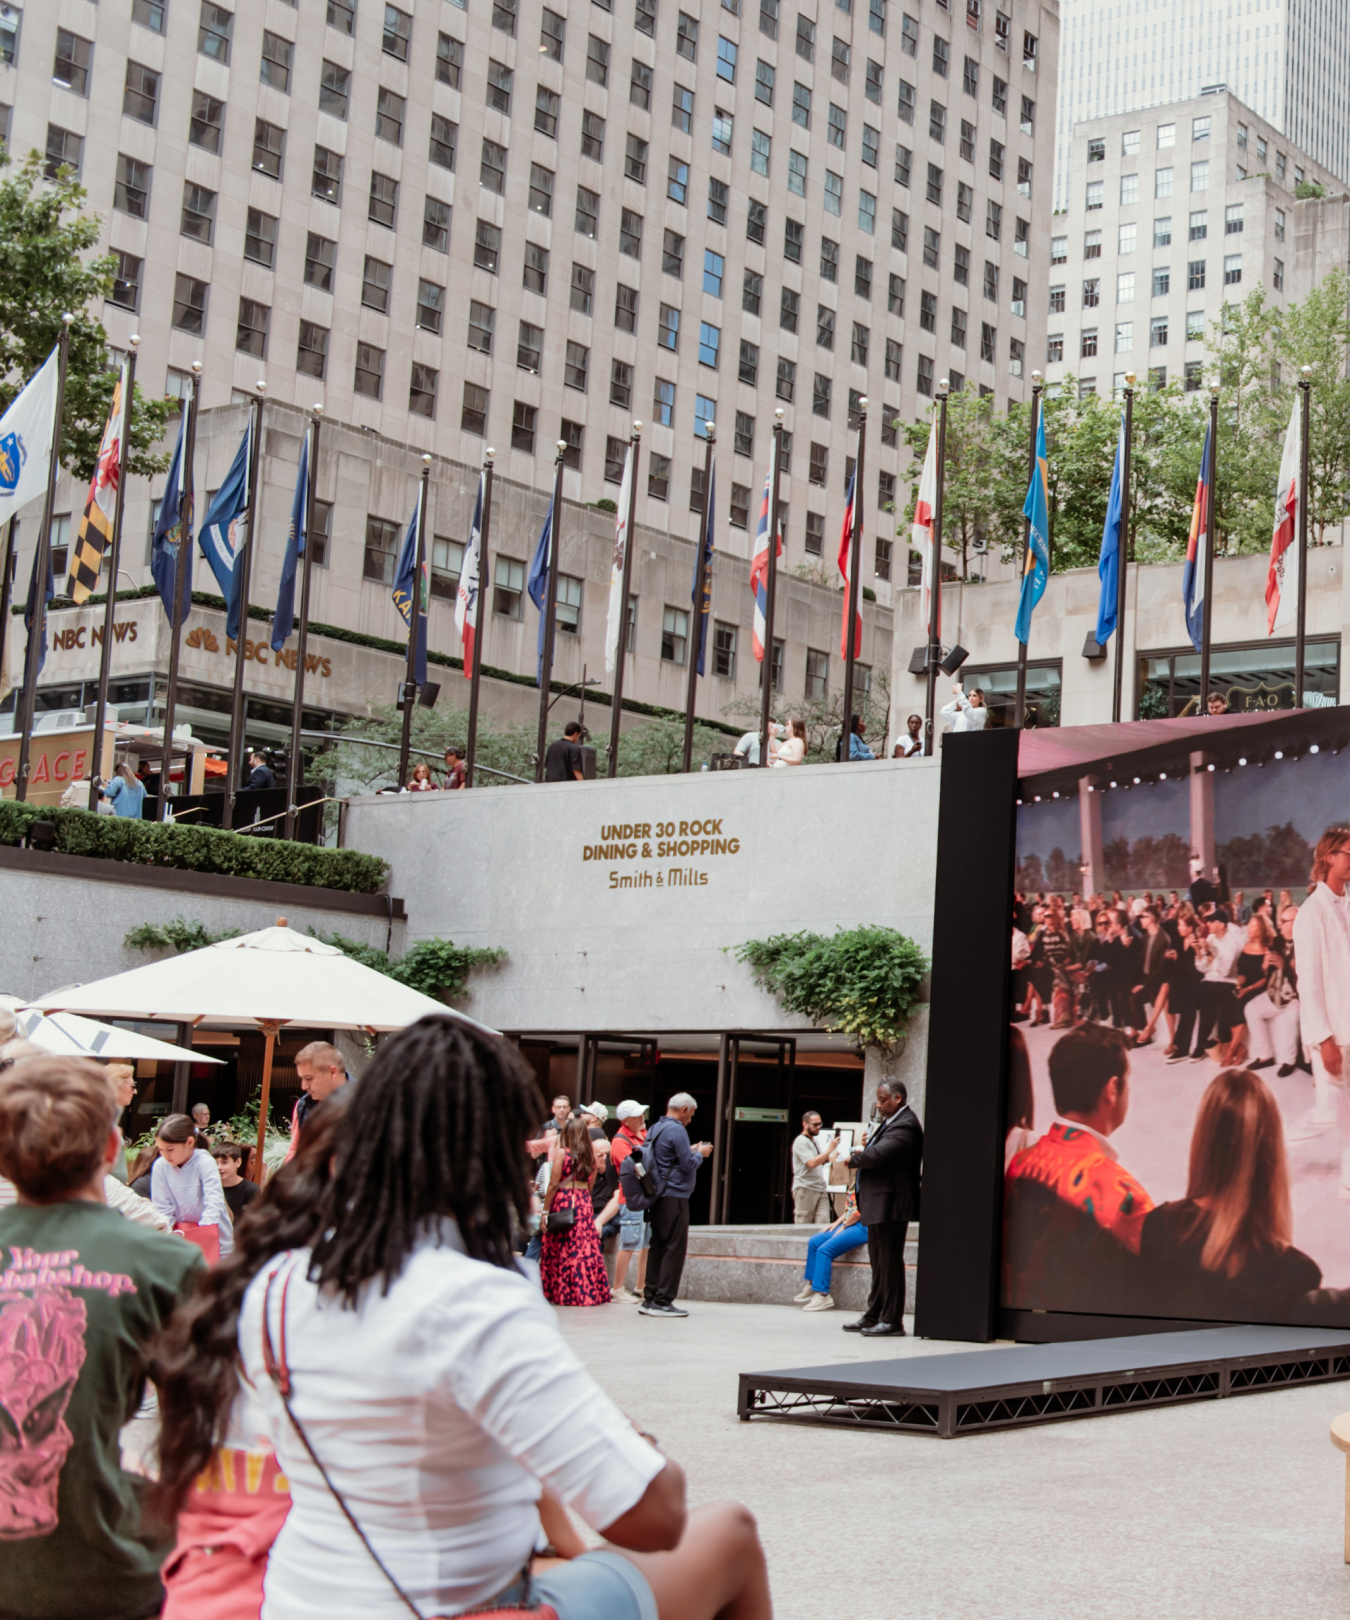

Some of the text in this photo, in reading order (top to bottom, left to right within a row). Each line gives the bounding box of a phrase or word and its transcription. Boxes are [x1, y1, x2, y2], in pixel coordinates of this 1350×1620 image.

[53, 621, 137, 651] NBC NWS
[226, 636, 331, 677] NBC NEWS
[0, 748, 88, 788] GACE
[600, 818, 724, 841] UNDER 30 ROCK
[582, 837, 741, 861] DINING & SHOPPING
[609, 867, 709, 889] Smith & Mills
[9, 1245, 80, 1271] Your
